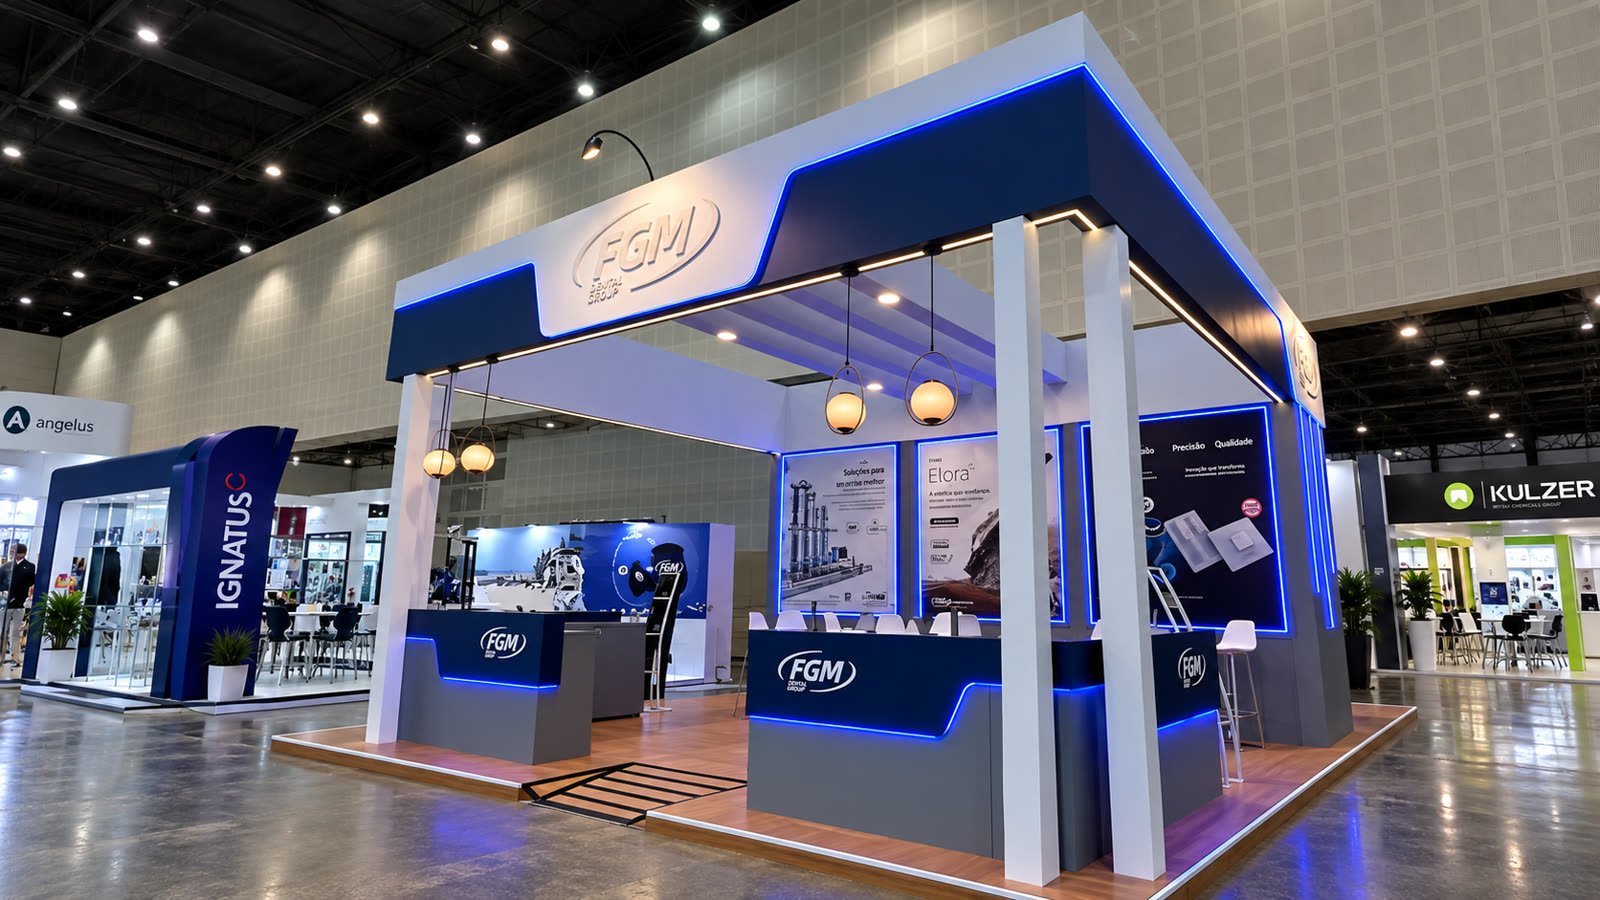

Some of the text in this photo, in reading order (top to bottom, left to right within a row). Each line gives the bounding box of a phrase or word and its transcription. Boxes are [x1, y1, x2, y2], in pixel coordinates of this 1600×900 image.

[593, 205, 696, 282] FGM
[36, 418, 95, 434] angelus
[1172, 441, 1206, 452] Precisão
[1214, 437, 1254, 449] Qualidade
[843, 467, 885, 477] Soluções para
[929, 467, 969, 484] Elora
[1490, 480, 1596, 502] KULZER
[659, 562, 680, 573] FGM
[486, 632, 520, 652] FGM
[789, 658, 845, 684] FGM
[1183, 655, 1202, 679] FGM
